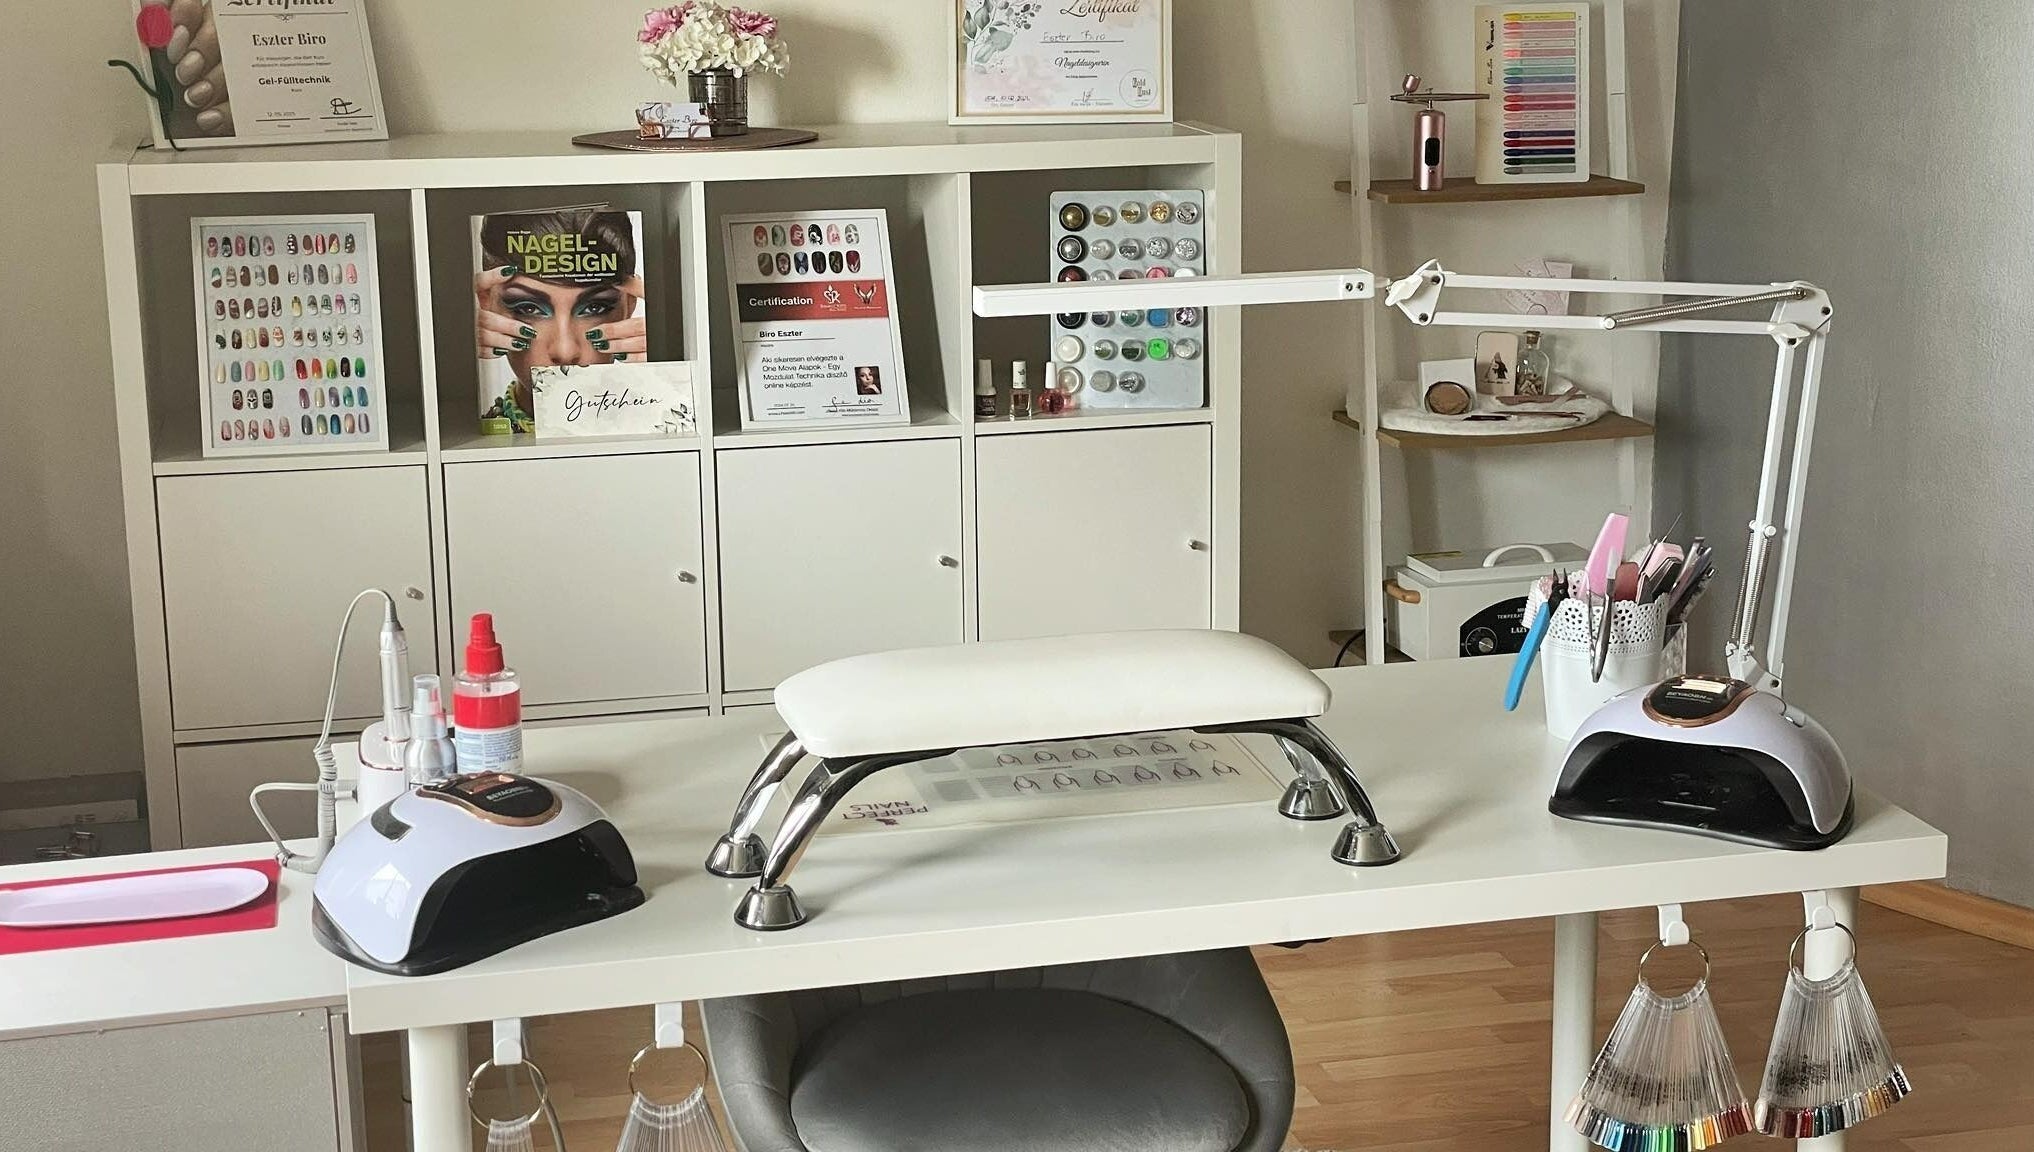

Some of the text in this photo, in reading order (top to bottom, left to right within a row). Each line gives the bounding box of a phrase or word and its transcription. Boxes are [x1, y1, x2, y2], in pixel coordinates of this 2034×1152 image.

[252, 33, 326, 46] Eszter Biro
[1054, 57, 1110, 69] Nageldesignerin
[259, 75, 331, 86] Gel-Fülltechnik
[507, 233, 597, 254] NAGEL-
[524, 253, 617, 273] DESIGN
[749, 297, 813, 307] Certification
[827, 363, 841, 371] Egy
[565, 388, 663, 422] Gutschein
[850, 801, 910, 812] NAILS
[842, 806, 928, 820] PERFECT
